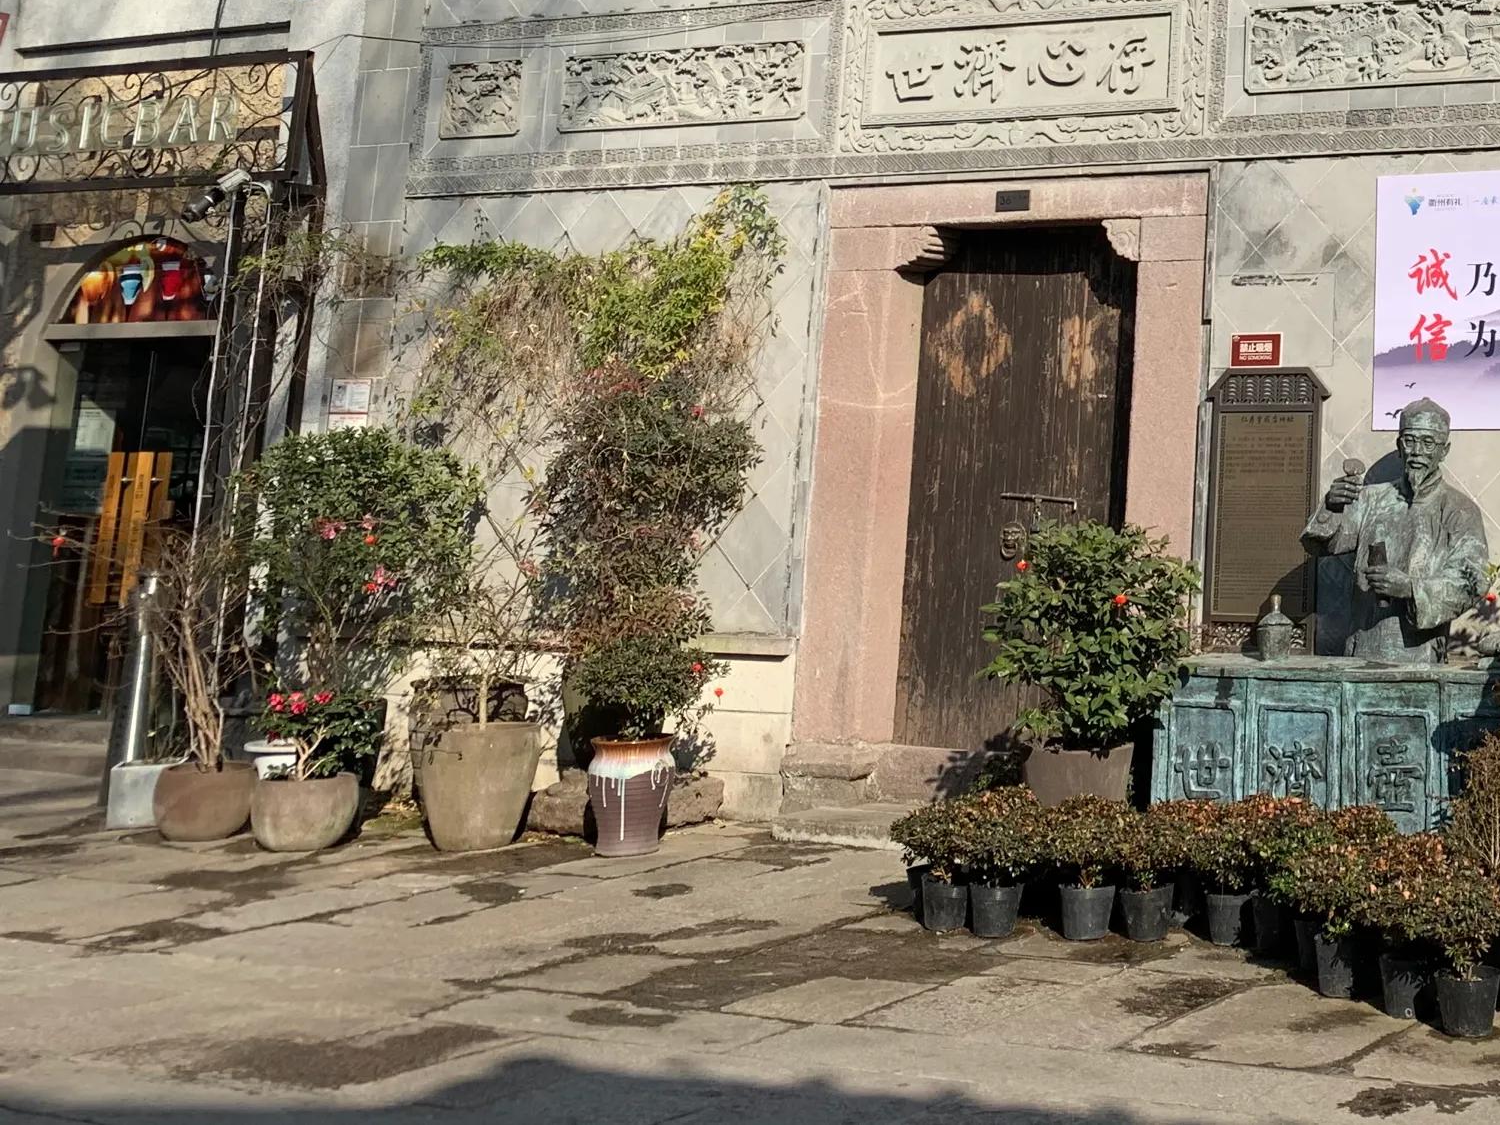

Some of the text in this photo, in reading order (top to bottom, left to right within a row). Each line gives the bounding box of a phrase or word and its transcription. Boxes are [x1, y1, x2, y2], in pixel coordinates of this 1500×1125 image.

[0, 94, 237, 151] USICBAR
[1428, 197, 1463, 207] 衢州有礼
